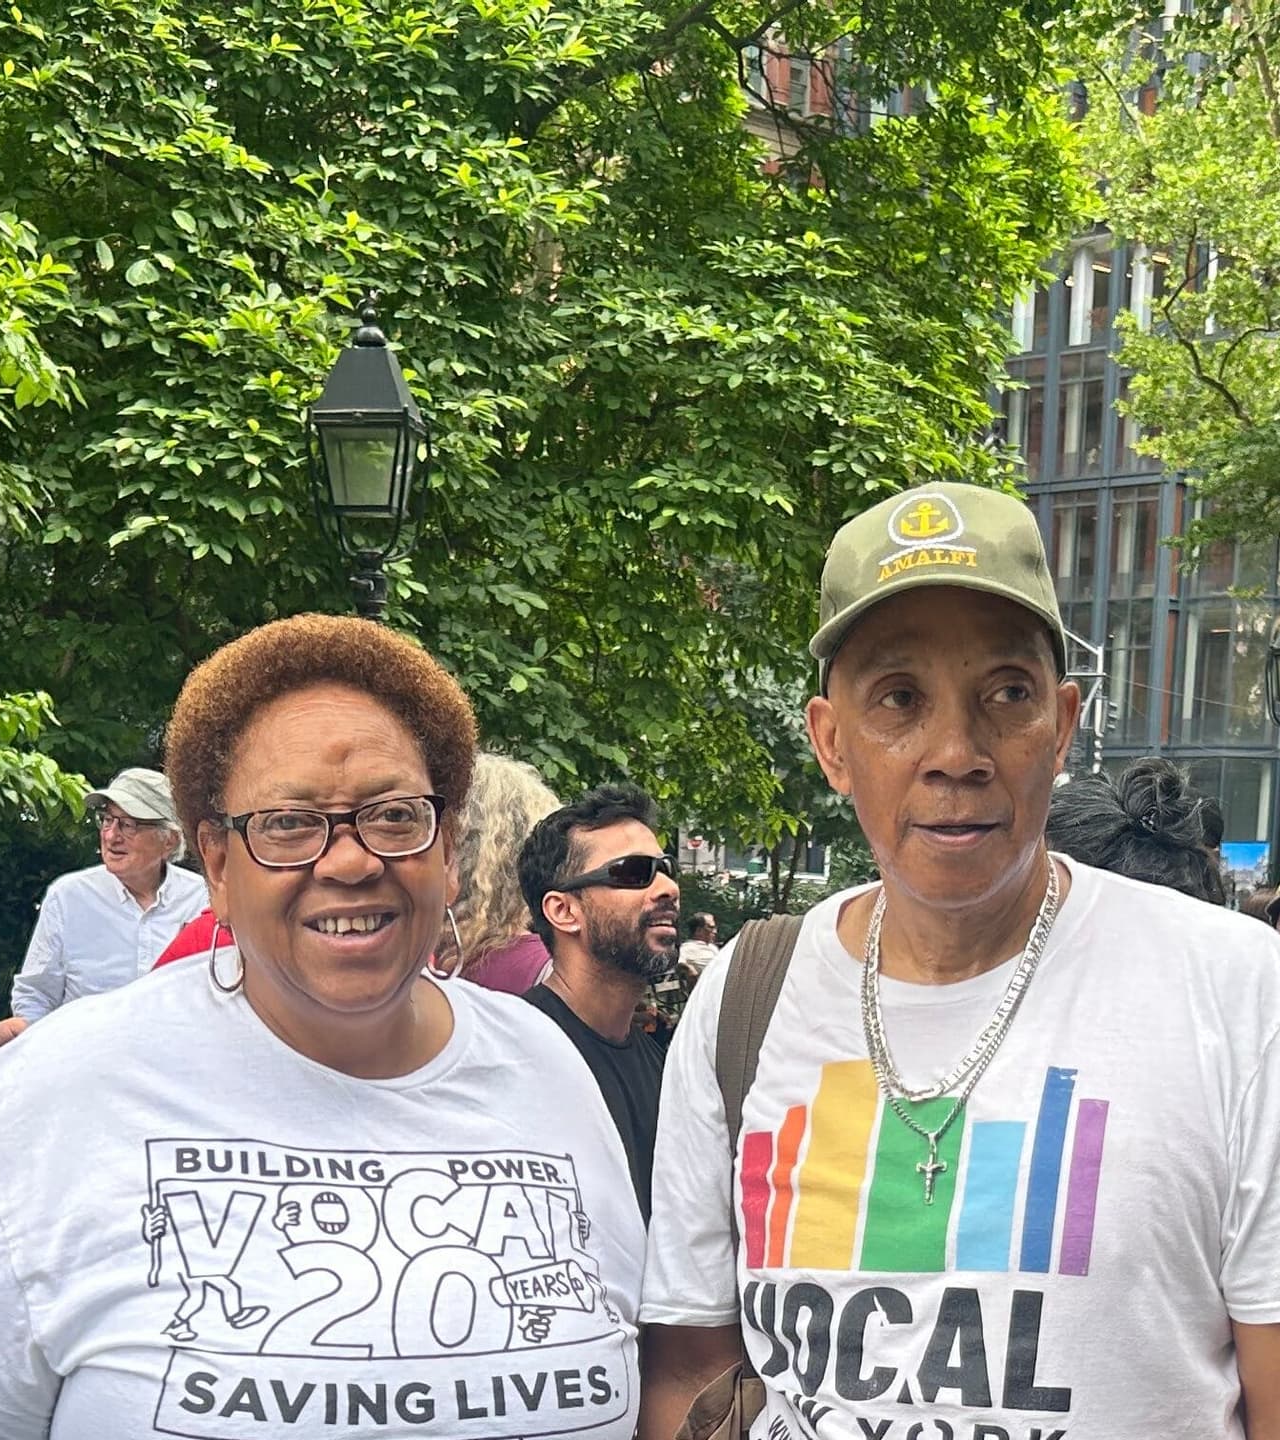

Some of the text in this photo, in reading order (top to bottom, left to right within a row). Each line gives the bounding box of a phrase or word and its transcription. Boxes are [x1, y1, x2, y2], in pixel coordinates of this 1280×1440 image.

[877, 549, 977, 583] AMALFI
[175, 1147, 569, 1186] BUILDING POWER.
[162, 1167, 601, 1284] VOCAL
[257, 1239, 513, 1359] 20
[508, 1271, 571, 1300] YEARS
[743, 1281, 1073, 1413] VOCAL
[179, 1366, 621, 1426] SAVING LIVES.
